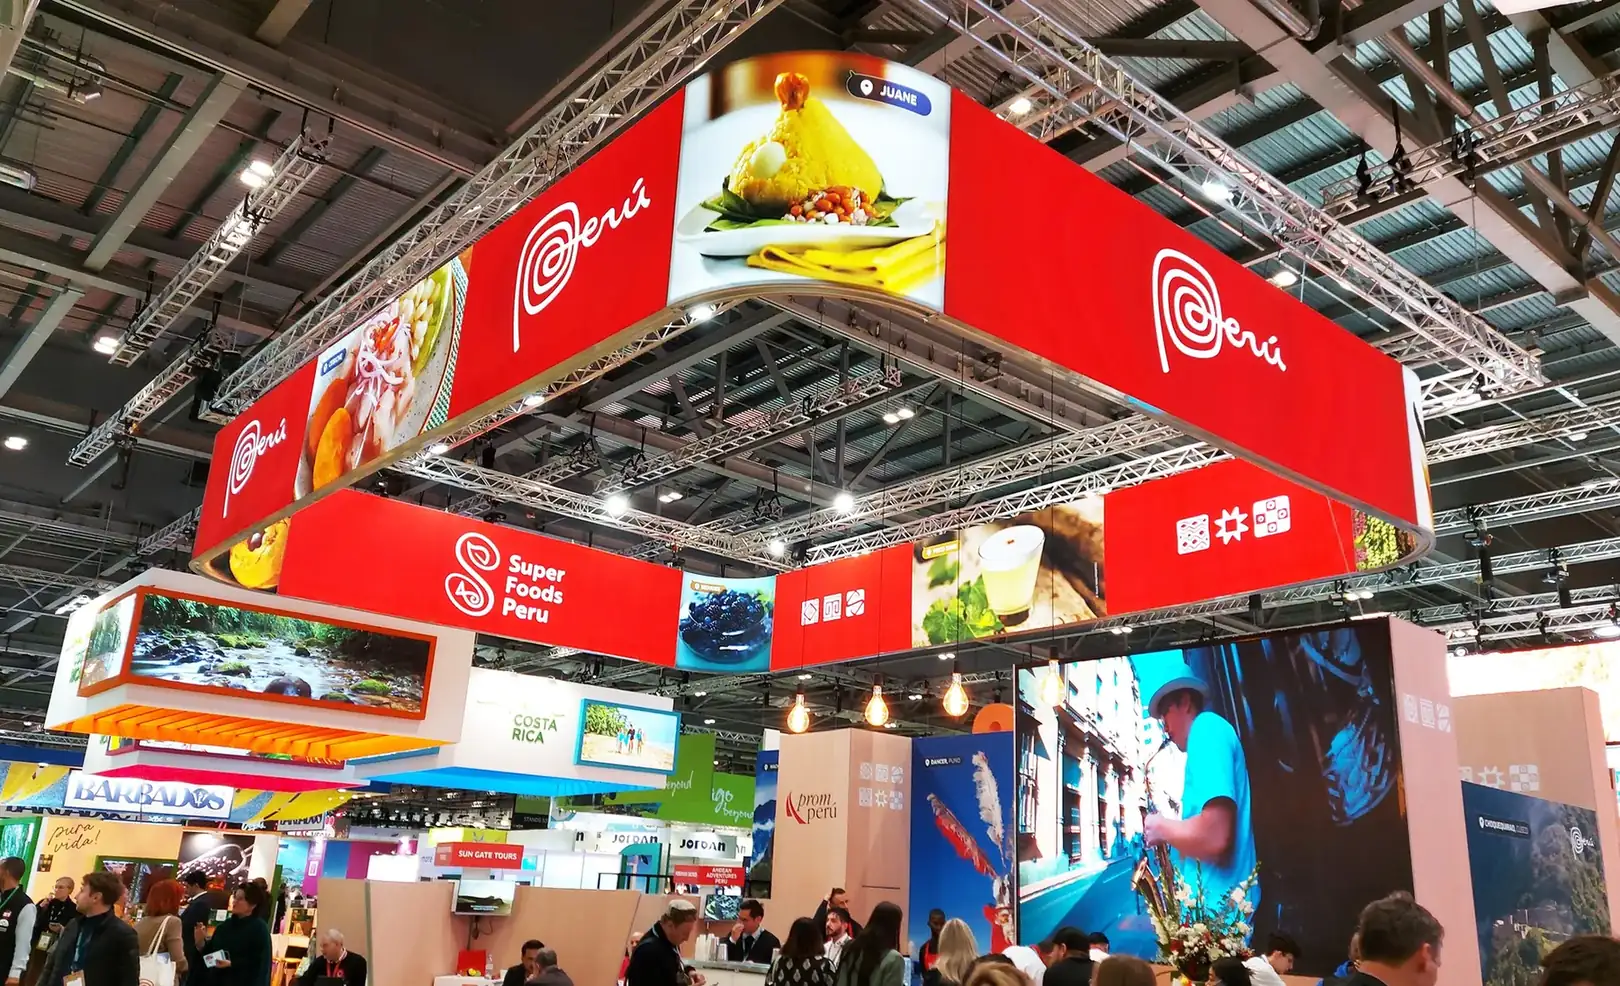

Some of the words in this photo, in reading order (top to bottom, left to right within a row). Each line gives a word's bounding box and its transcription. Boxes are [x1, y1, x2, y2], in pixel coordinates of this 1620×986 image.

[880, 85, 918, 106] JUANE
[513, 177, 651, 353] Perú
[1152, 248, 1287, 374] Perú
[222, 418, 287, 519] Perú
[508, 554, 566, 583] Super
[505, 575, 564, 604] Foods
[502, 597, 550, 623] Peru
[514, 714, 558, 732] COSTA
[512, 727, 544, 744] RICA
[73, 778, 225, 811] BARBADOS
[665, 770, 694, 797] eyond
[797, 791, 832, 811] prom
[807, 802, 837, 824] perú
[48, 823, 94, 845] pura
[54, 830, 102, 853] vida!
[458, 849, 473, 858] SUN
[474, 850, 493, 859] GATE
[494, 852, 517, 860] TOURS
